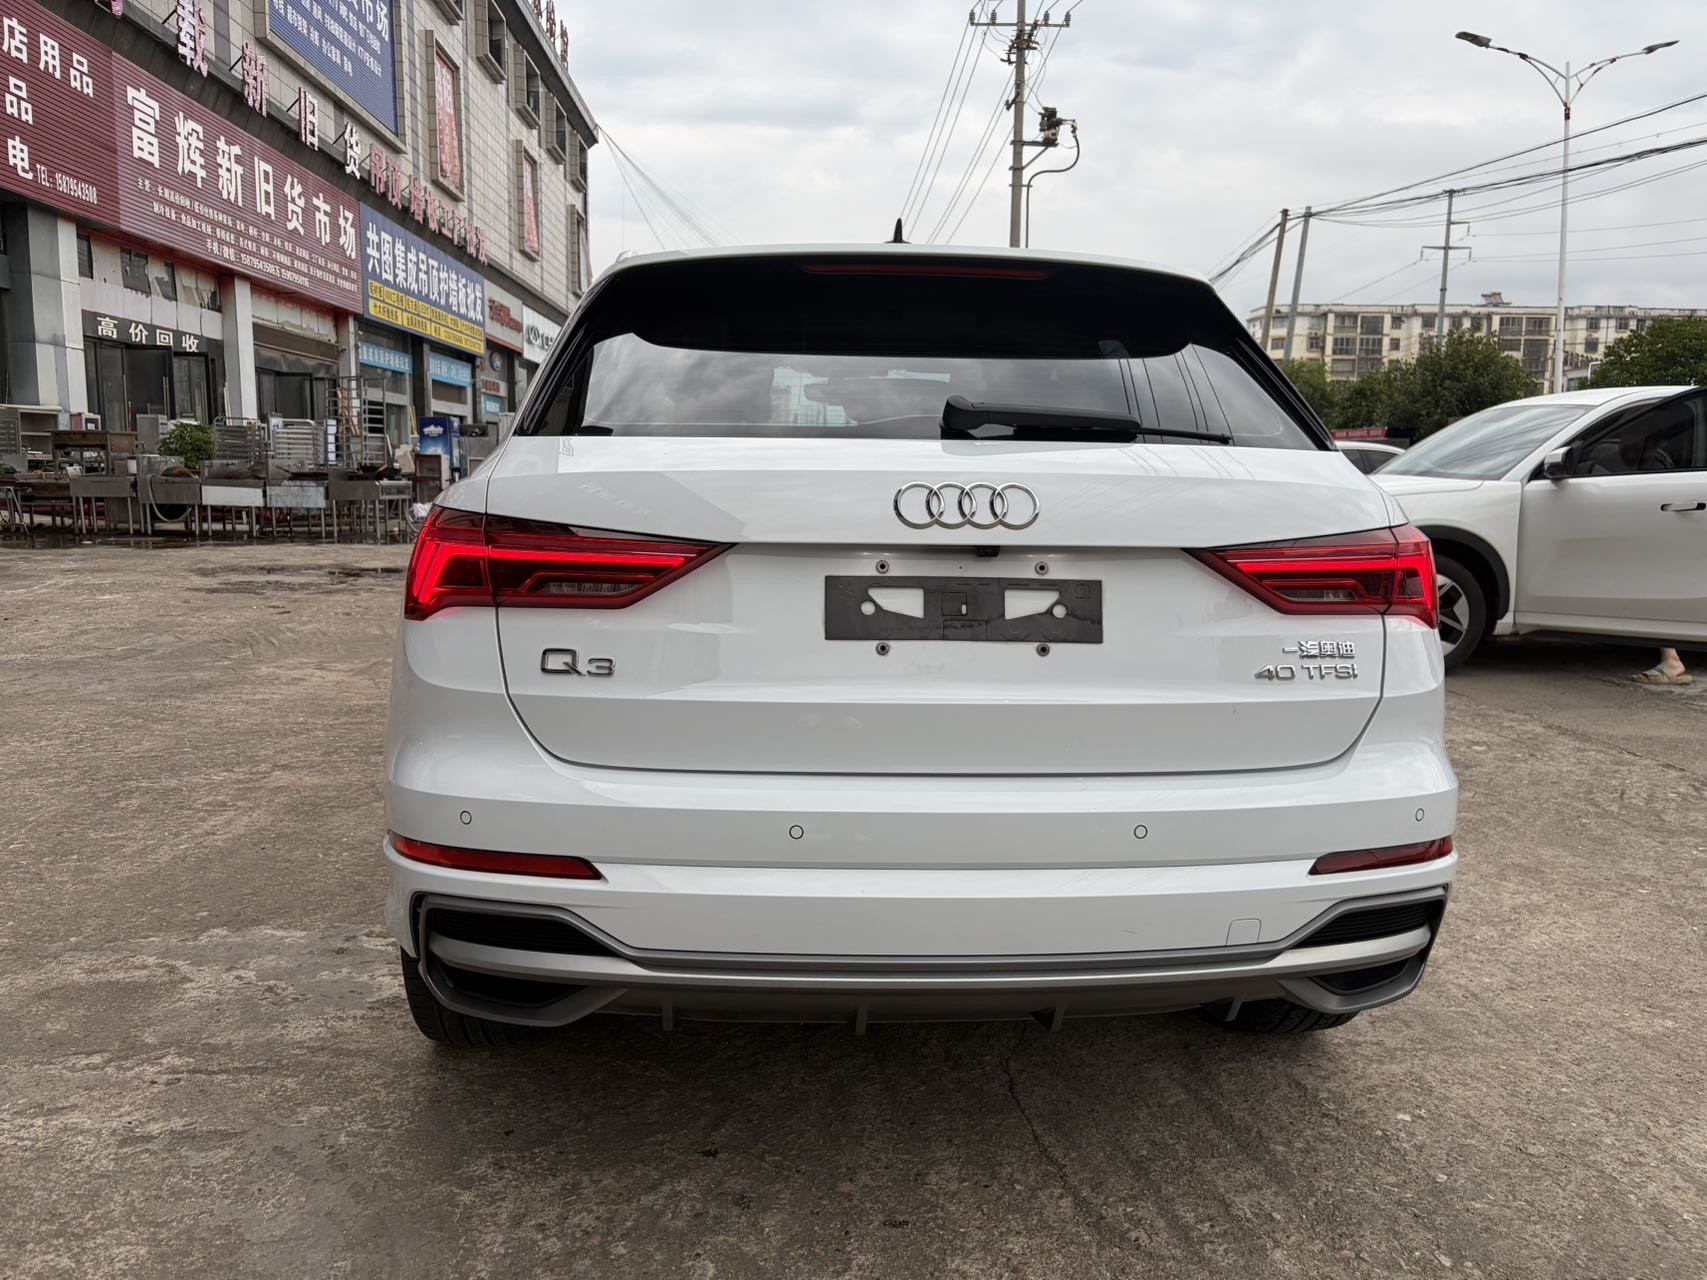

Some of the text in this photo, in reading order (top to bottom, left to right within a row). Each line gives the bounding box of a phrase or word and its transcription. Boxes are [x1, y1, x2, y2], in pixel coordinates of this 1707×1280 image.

[2, 17, 94, 98] 店用品
[5, 75, 34, 125] 品
[7, 135, 34, 180] 电
[126, 85, 356, 260] 富辉新旧货市场
[366, 222, 483, 322] 共图集成吊顶护墙板批发
[97, 317, 199, 352] 高价回收
[540, 647, 615, 677] Q3
[1282, 640, 1356, 659] 一汽奥迪
[1254, 664, 1296, 681] 40
